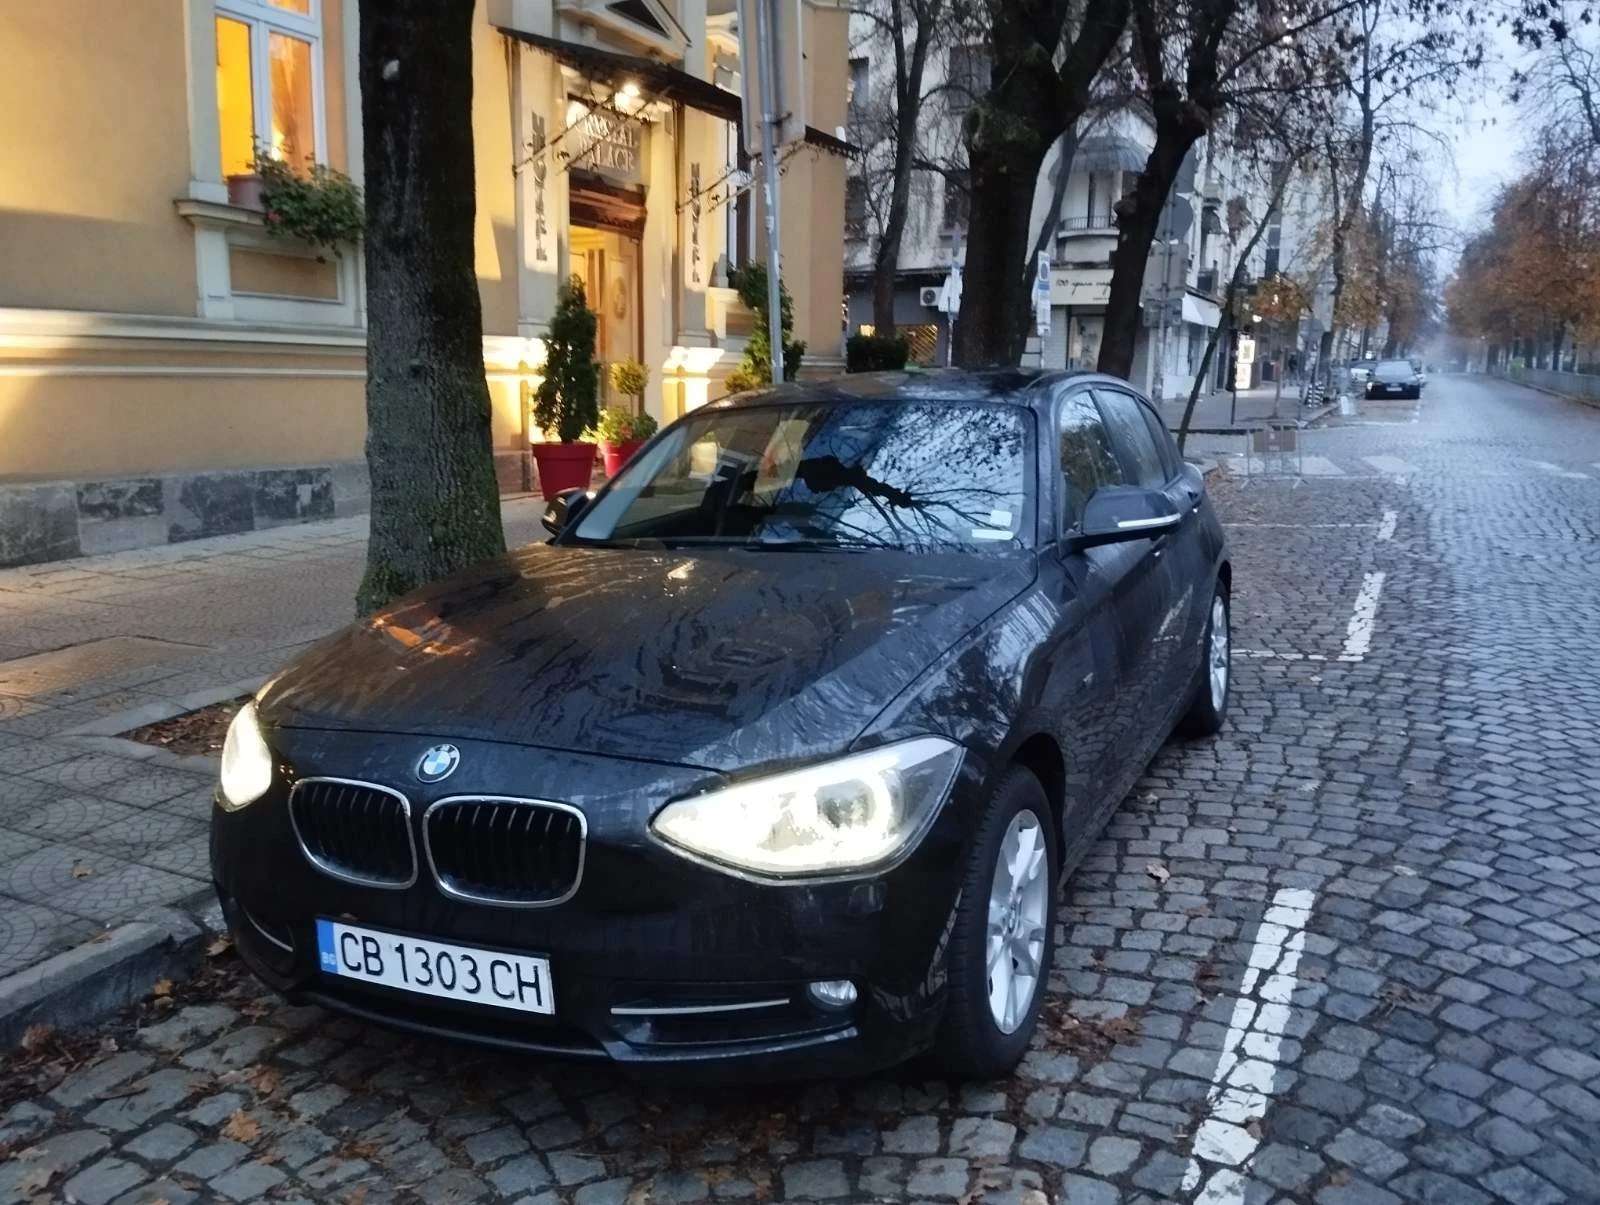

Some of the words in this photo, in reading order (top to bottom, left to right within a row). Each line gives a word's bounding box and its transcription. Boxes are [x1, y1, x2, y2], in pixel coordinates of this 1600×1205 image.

[340, 931, 384, 976] CB
[394, 943, 482, 994] 1303
[490, 959, 543, 1006] CH
